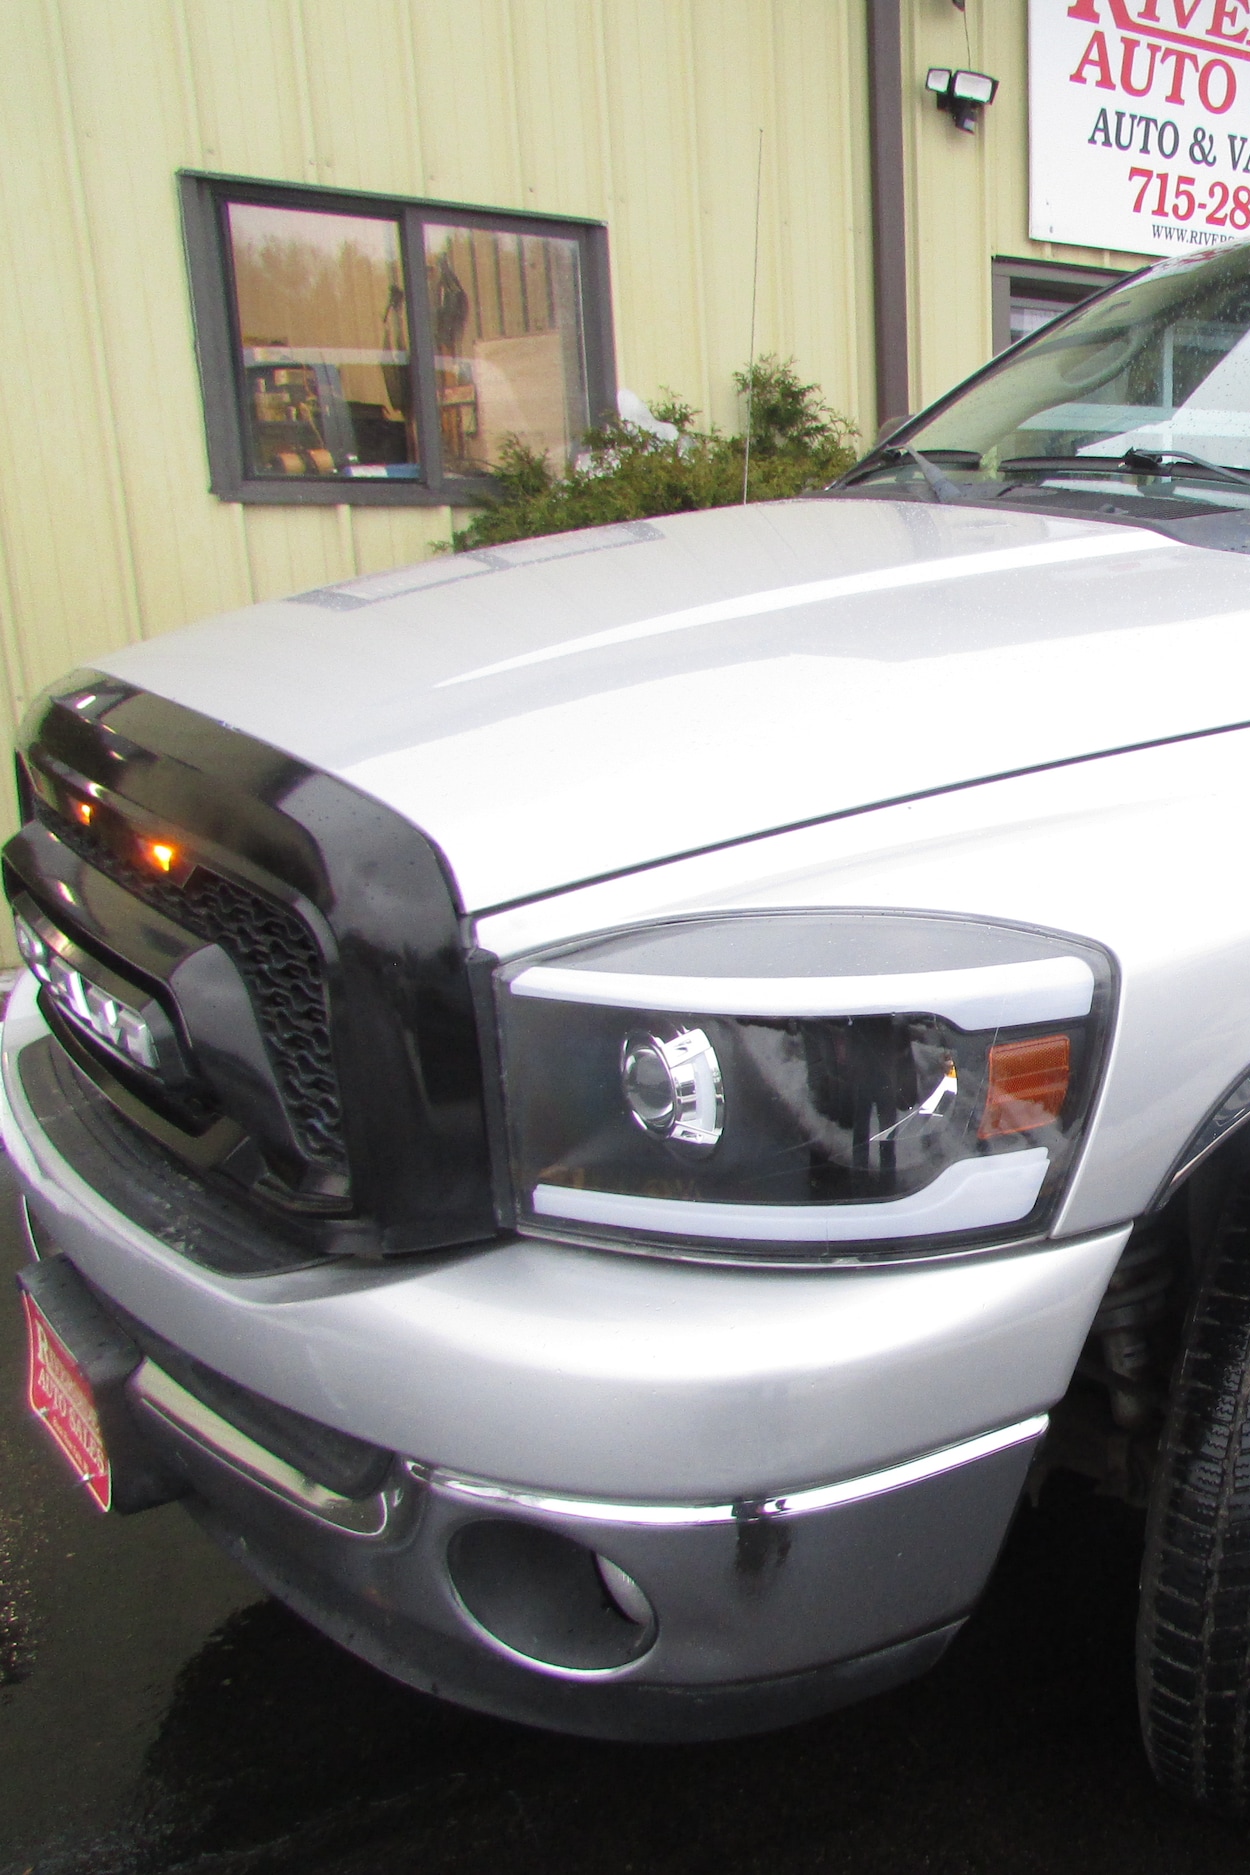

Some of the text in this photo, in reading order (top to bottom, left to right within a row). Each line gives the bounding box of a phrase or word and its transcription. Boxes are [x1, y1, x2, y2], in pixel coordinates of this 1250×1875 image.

[1069, 31, 1237, 114] AUTO
[1088, 108, 1180, 159] AUTO
[1189, 127, 1217, 167] &
